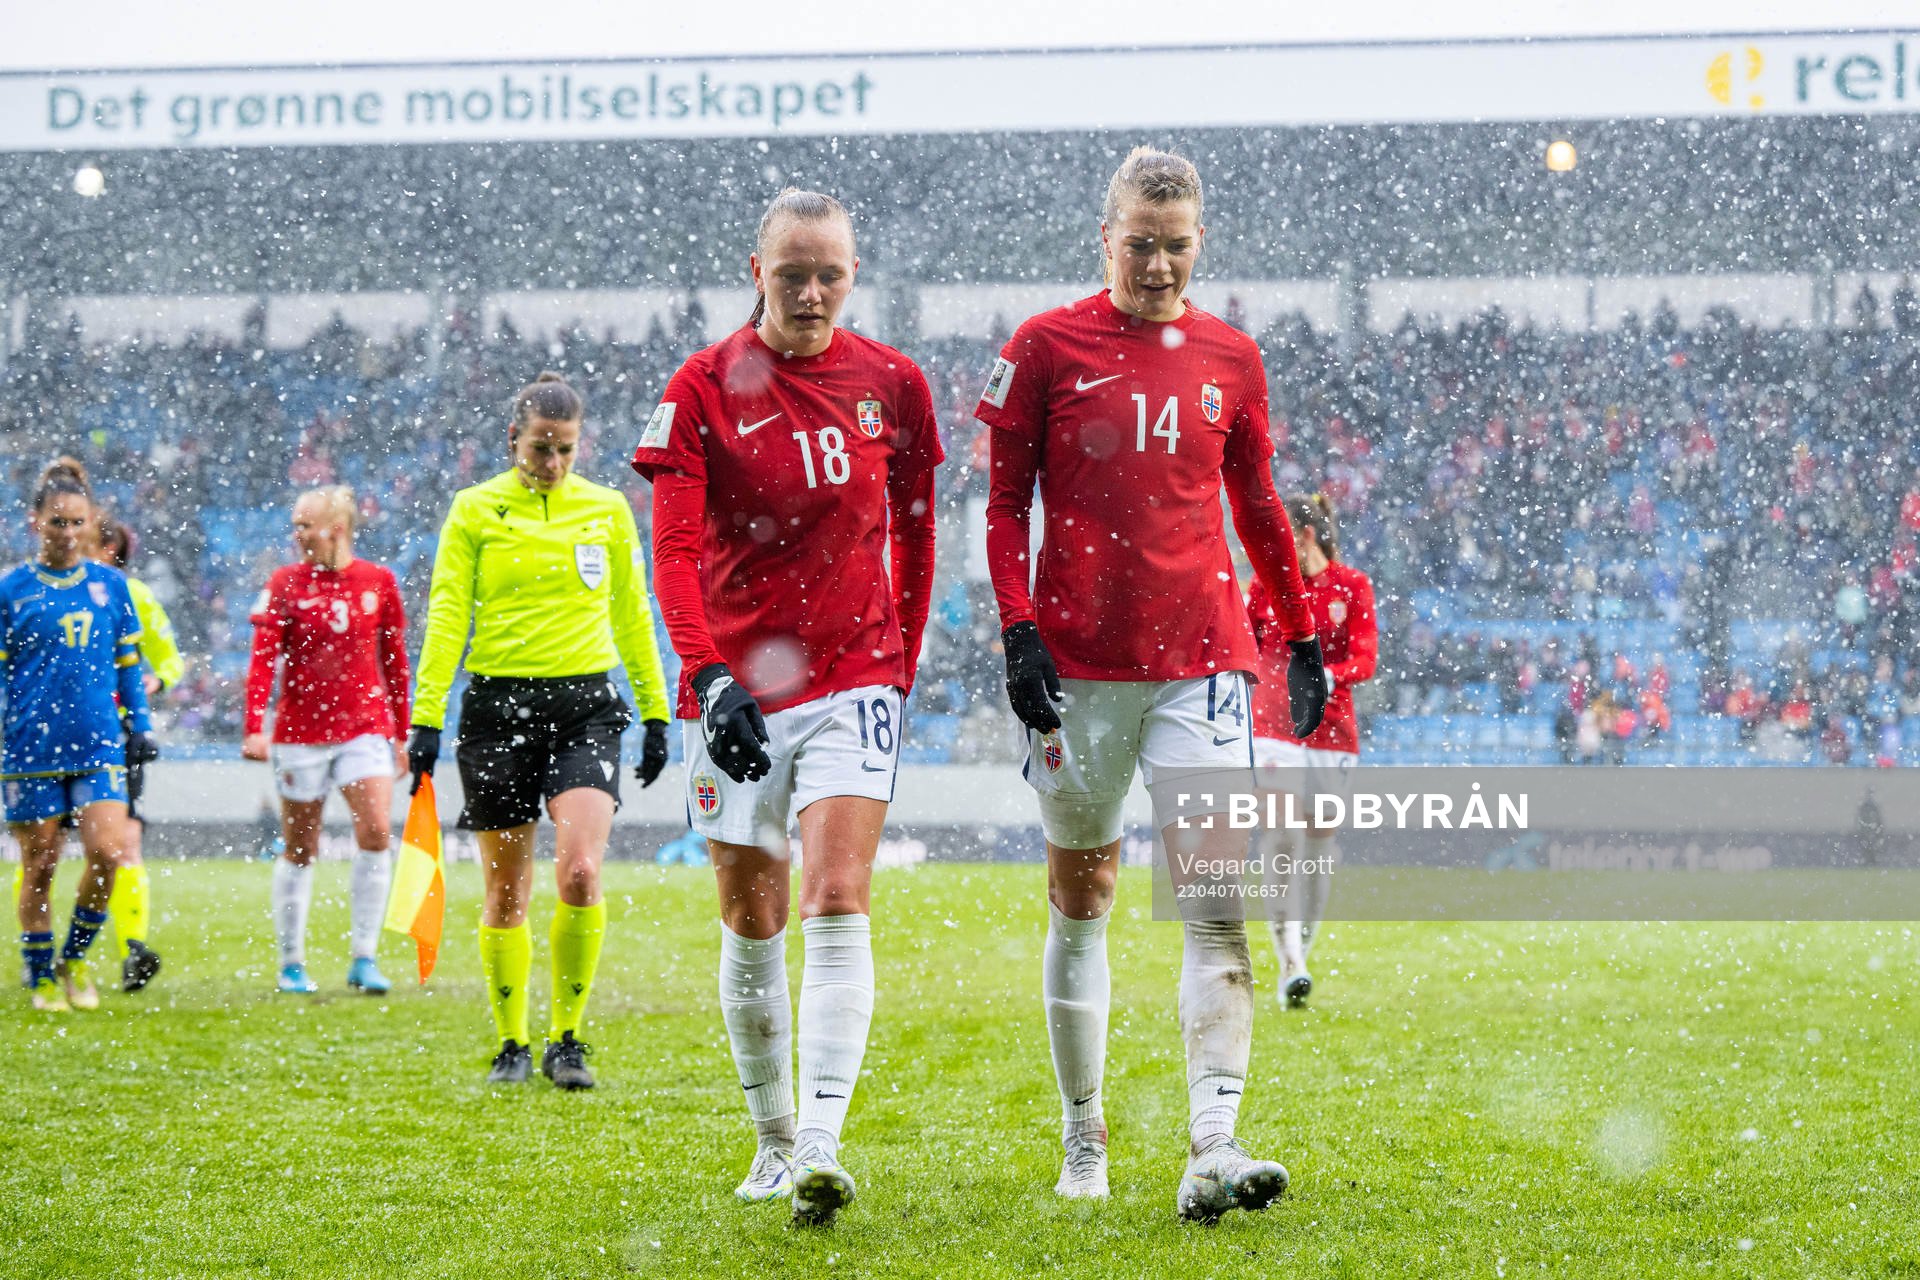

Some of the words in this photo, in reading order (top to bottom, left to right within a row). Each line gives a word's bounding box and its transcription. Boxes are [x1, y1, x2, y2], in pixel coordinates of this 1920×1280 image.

[1795, 40, 1920, 102] rel
[47, 86, 149, 131] Det
[169, 92, 384, 140] grønne
[404, 71, 876, 129] mobilselskapet
[1131, 393, 1181, 455] 14
[792, 426, 851, 489] 18
[57, 610, 94, 648] 17
[328, 599, 349, 634] 3
[852, 698, 893, 755] 18
[1207, 673, 1245, 727] 14
